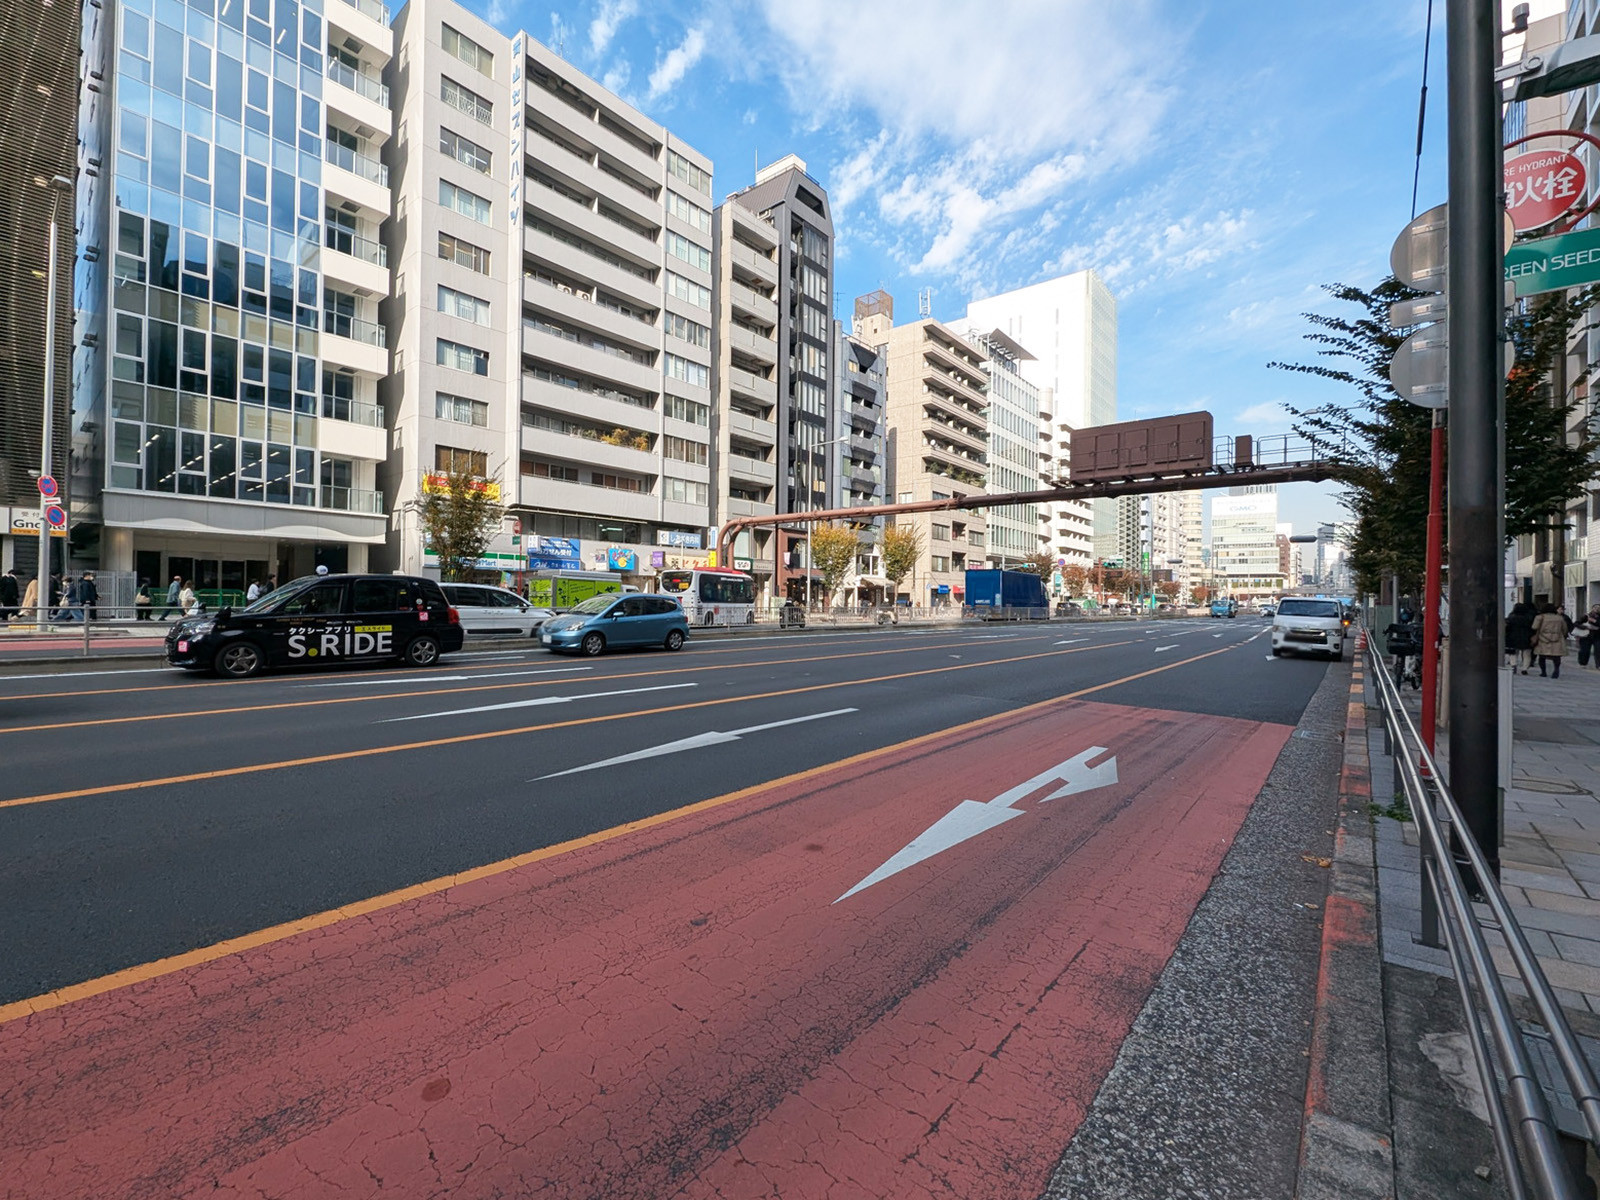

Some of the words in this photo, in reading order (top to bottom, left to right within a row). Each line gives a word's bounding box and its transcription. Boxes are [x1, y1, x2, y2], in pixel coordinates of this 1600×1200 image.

[1504, 166, 1515, 177] RE
[1519, 154, 1567, 173] HYDRANT
[288, 625, 352, 635] タクシーアプリ
[287, 632, 393, 658] S.RIDE
